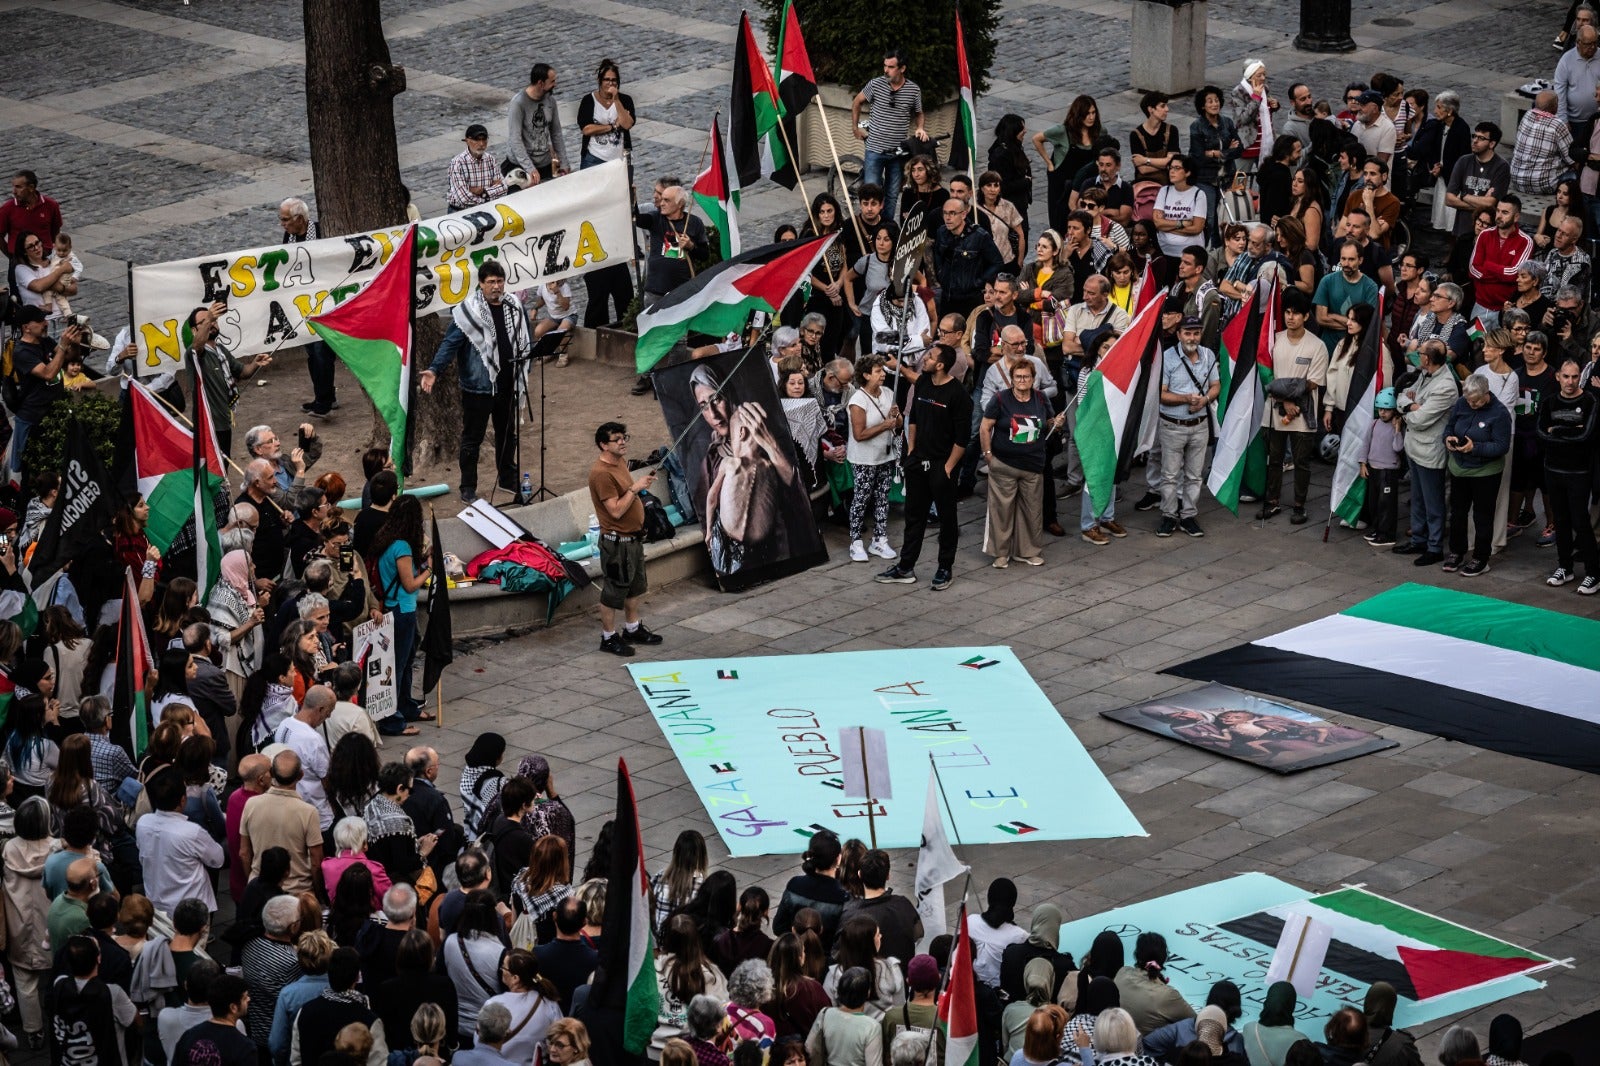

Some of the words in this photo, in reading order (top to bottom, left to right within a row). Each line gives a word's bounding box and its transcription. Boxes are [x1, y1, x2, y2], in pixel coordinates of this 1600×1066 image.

[896, 229, 927, 261] GENOCIDIO
[906, 211, 924, 236] STOP
[198, 246, 315, 303] ESTA
[344, 204, 525, 274] EUROPA
[640, 671, 736, 758] AGUANTA
[873, 681, 991, 769] LEVANTA
[766, 708, 843, 776] PUEBLO
[704, 778, 788, 837] GAZA
[831, 798, 888, 818] EL
[965, 786, 1028, 809] SE
[65, 1020, 98, 1066] STOP
